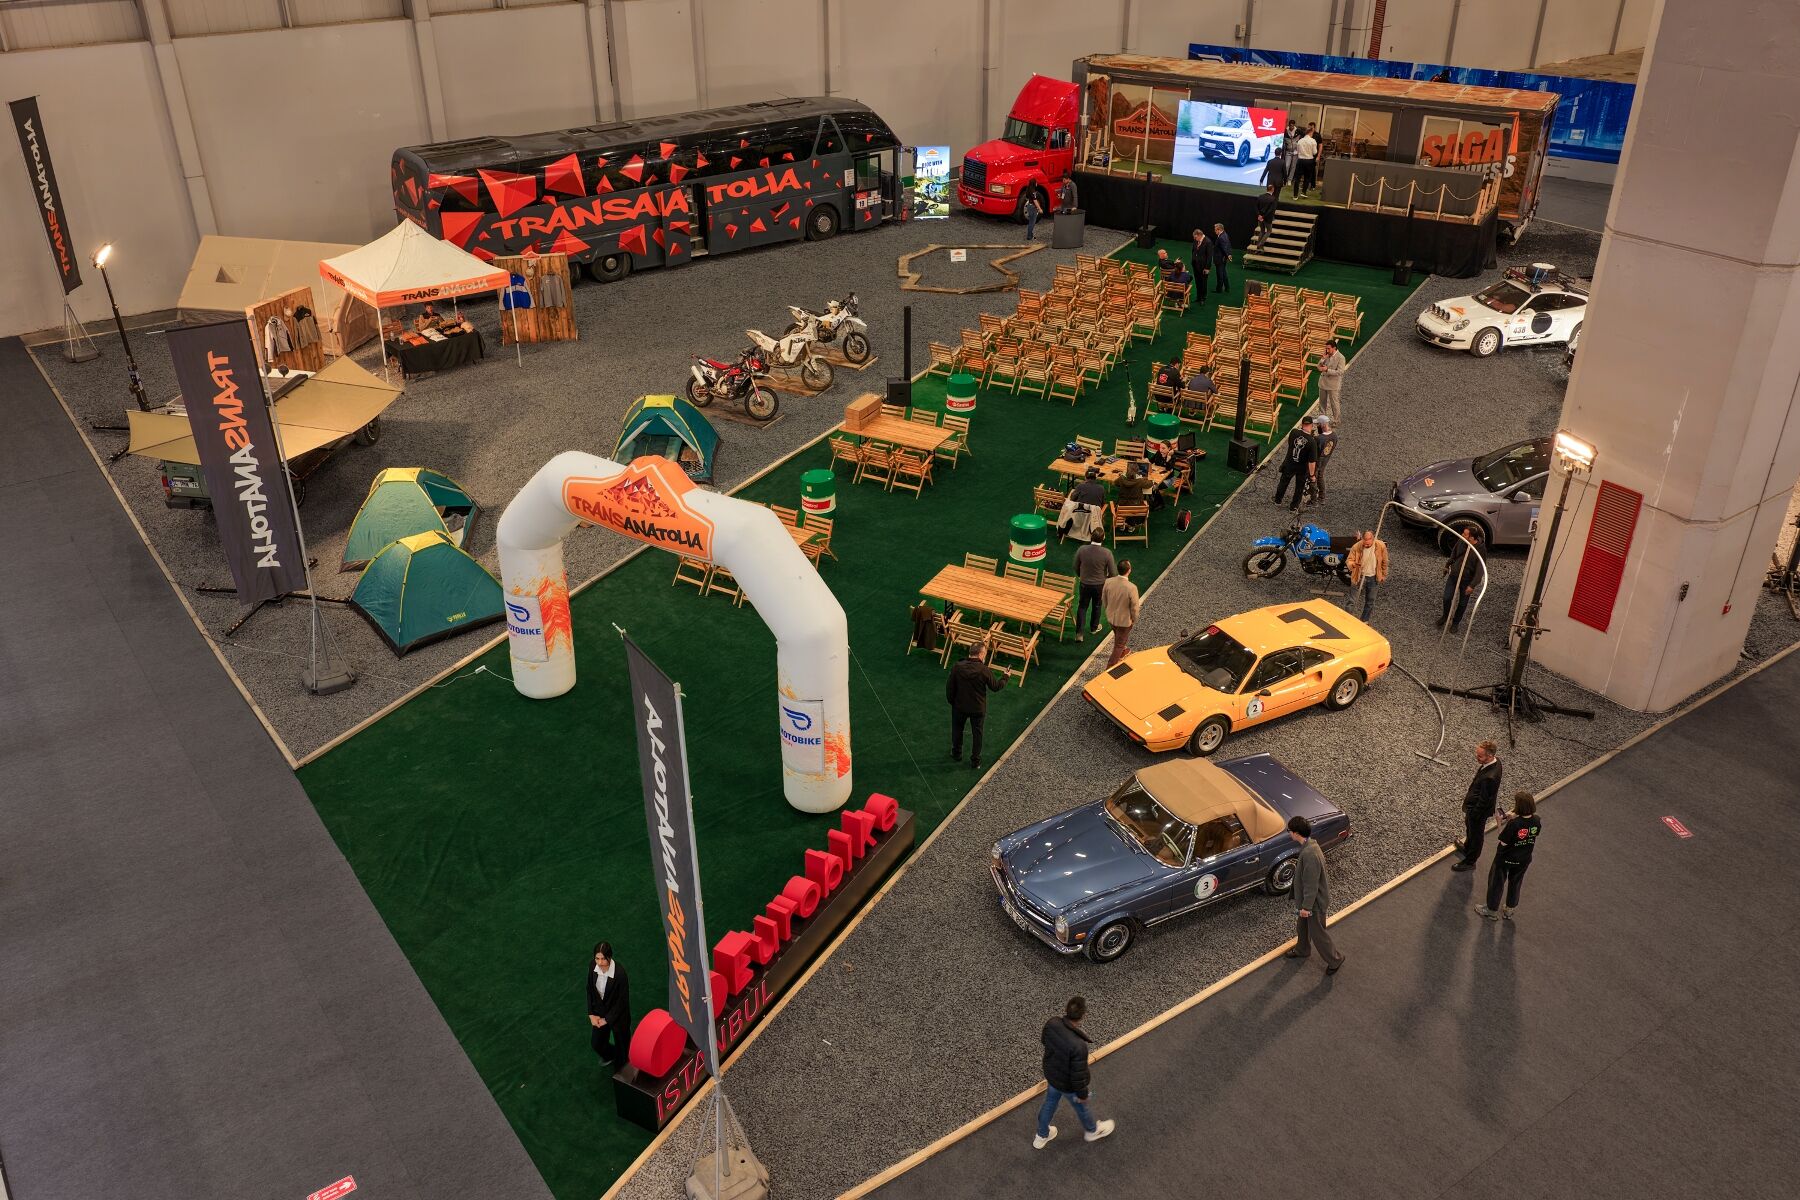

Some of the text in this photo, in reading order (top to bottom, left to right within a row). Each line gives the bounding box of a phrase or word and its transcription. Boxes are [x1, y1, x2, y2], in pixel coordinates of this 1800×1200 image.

[1423, 129, 1503, 167] SAGA
[24, 117, 72, 276] TRANSANATOLIA
[571, 496, 703, 551] TRANSANATOLIA
[1252, 704, 1258, 713] 2
[1203, 881, 1209, 890] 3
